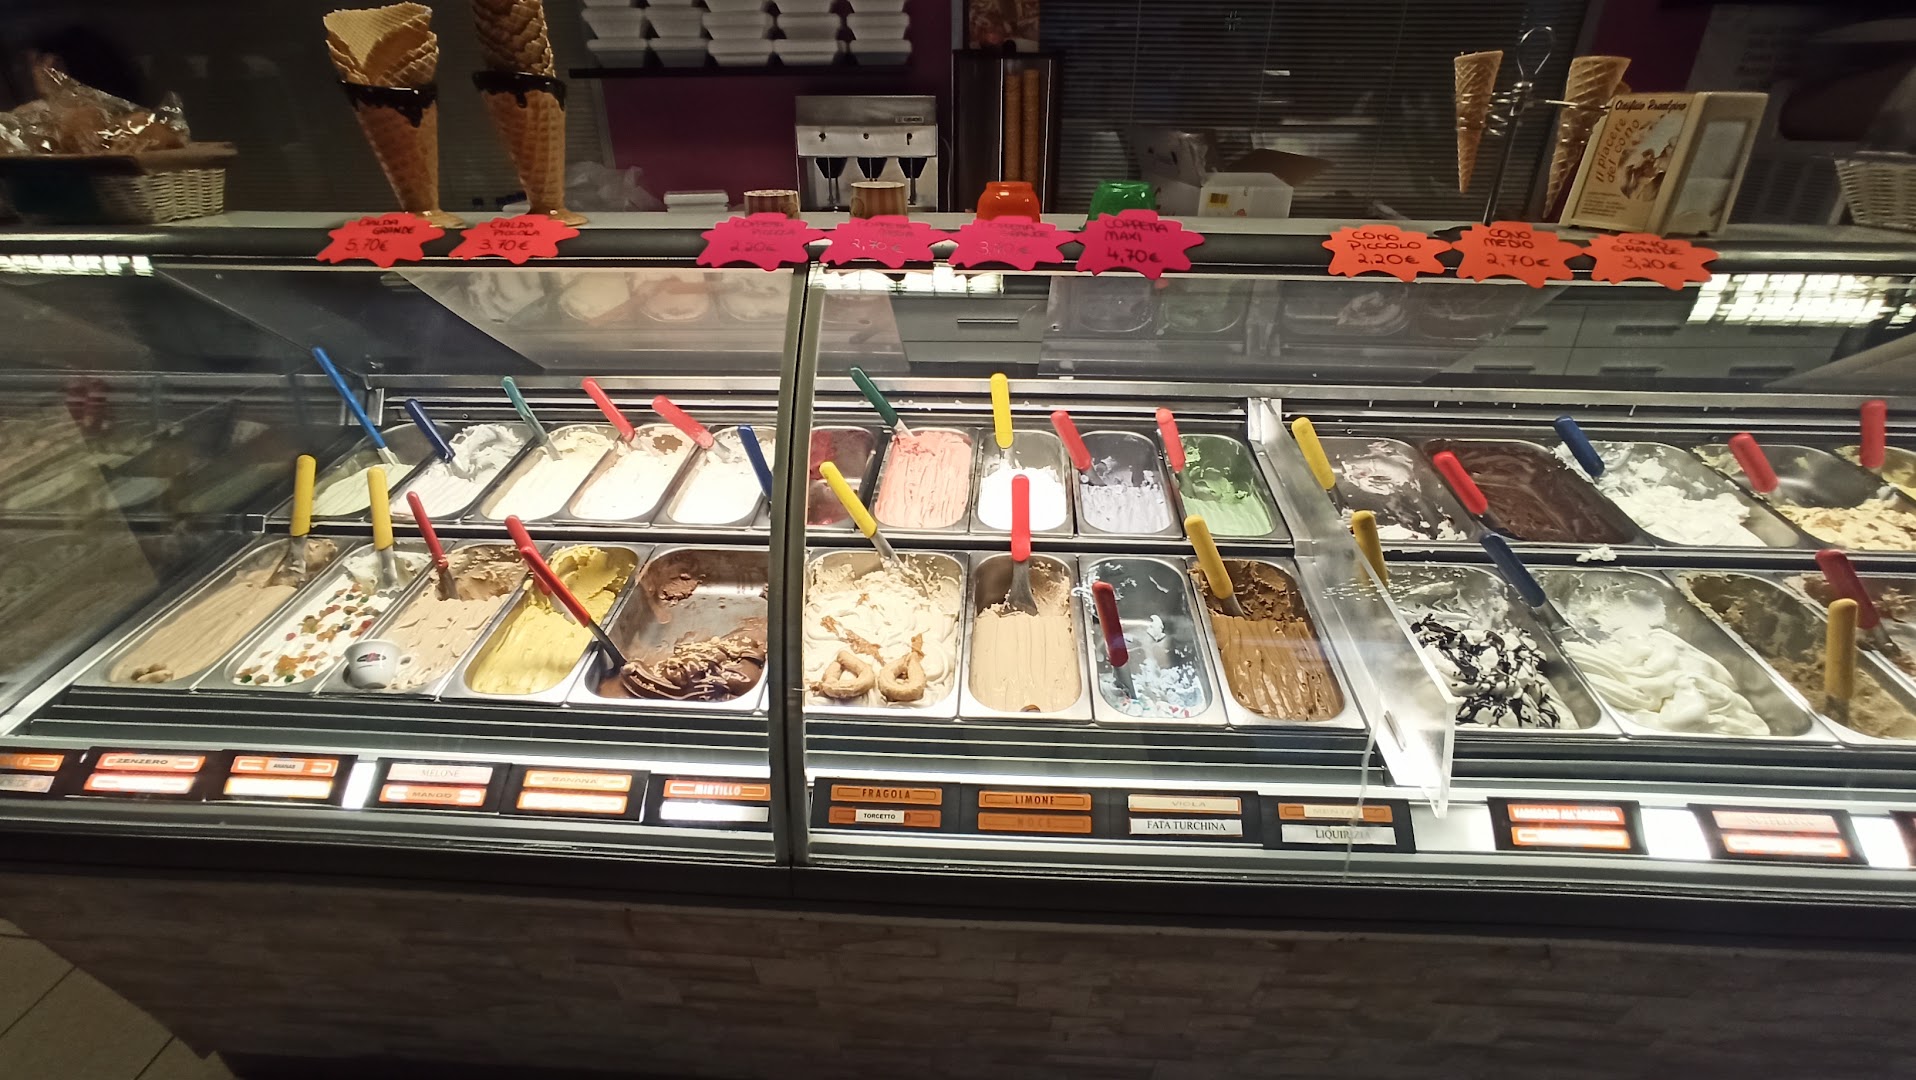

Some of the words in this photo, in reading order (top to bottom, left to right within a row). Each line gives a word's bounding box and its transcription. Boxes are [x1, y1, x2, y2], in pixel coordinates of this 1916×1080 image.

[358, 218, 399, 228] CIALDA
[490, 221, 534, 230] CIALDA
[1104, 219, 1168, 233] COPPETTA
[372, 226, 415, 235] GRANDE
[1351, 231, 1399, 242] CONO
[1488, 228, 1531, 240] CONO
[1104, 231, 1142, 243] MAXI
[1346, 239, 1422, 251] PICCOLO
[1483, 238, 1535, 250] MEDIO
[1358, 253, 1419, 265] 2,20€
[115, 757, 169, 766] ZENZERO
[273, 762, 296, 770] ANANAS
[421, 767, 460, 779] MELONE
[551, 775, 598, 785] BANANA
[861, 787, 911, 800] FRAGOLA
[1014, 794, 1055, 806] LIMONE
[1171, 800, 1207, 808] VIOLA
[863, 812, 896, 821] TORCETTO
[1016, 817, 1053, 829] NOCE
[1146, 820, 1172, 831] FATA
[1173, 820, 1227, 832] TURCHINA
